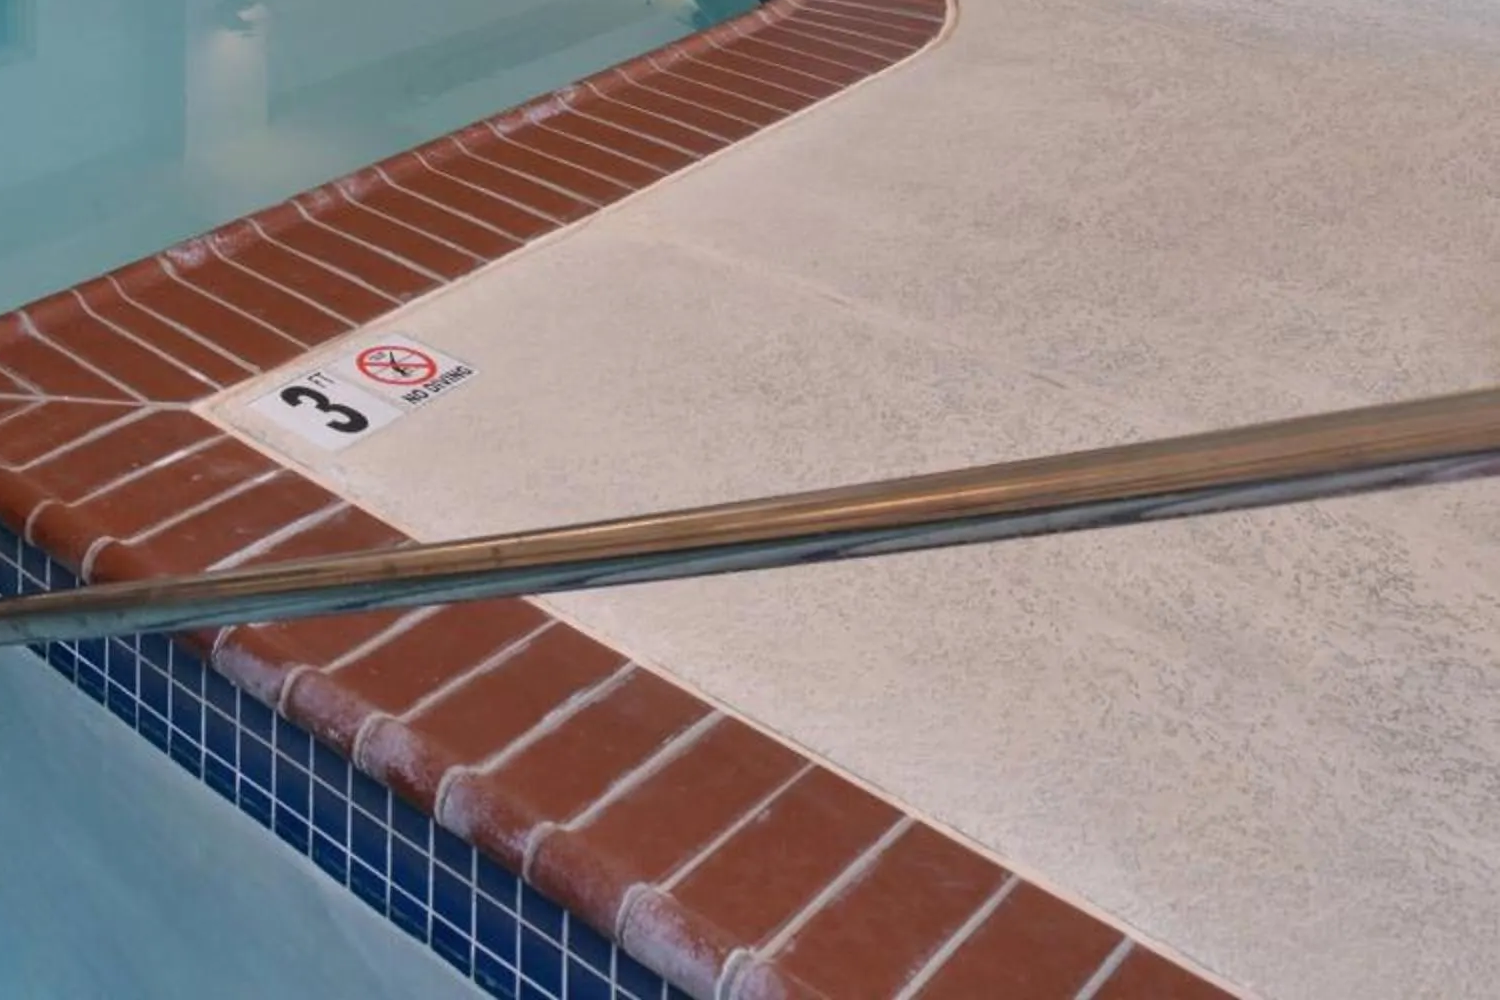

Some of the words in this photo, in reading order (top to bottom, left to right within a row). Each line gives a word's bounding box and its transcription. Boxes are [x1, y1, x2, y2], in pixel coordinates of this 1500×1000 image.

[307, 371, 335, 389] FT
[401, 389, 429, 405] NO
[423, 366, 473, 393] DIVING
[280, 386, 368, 433] 3
